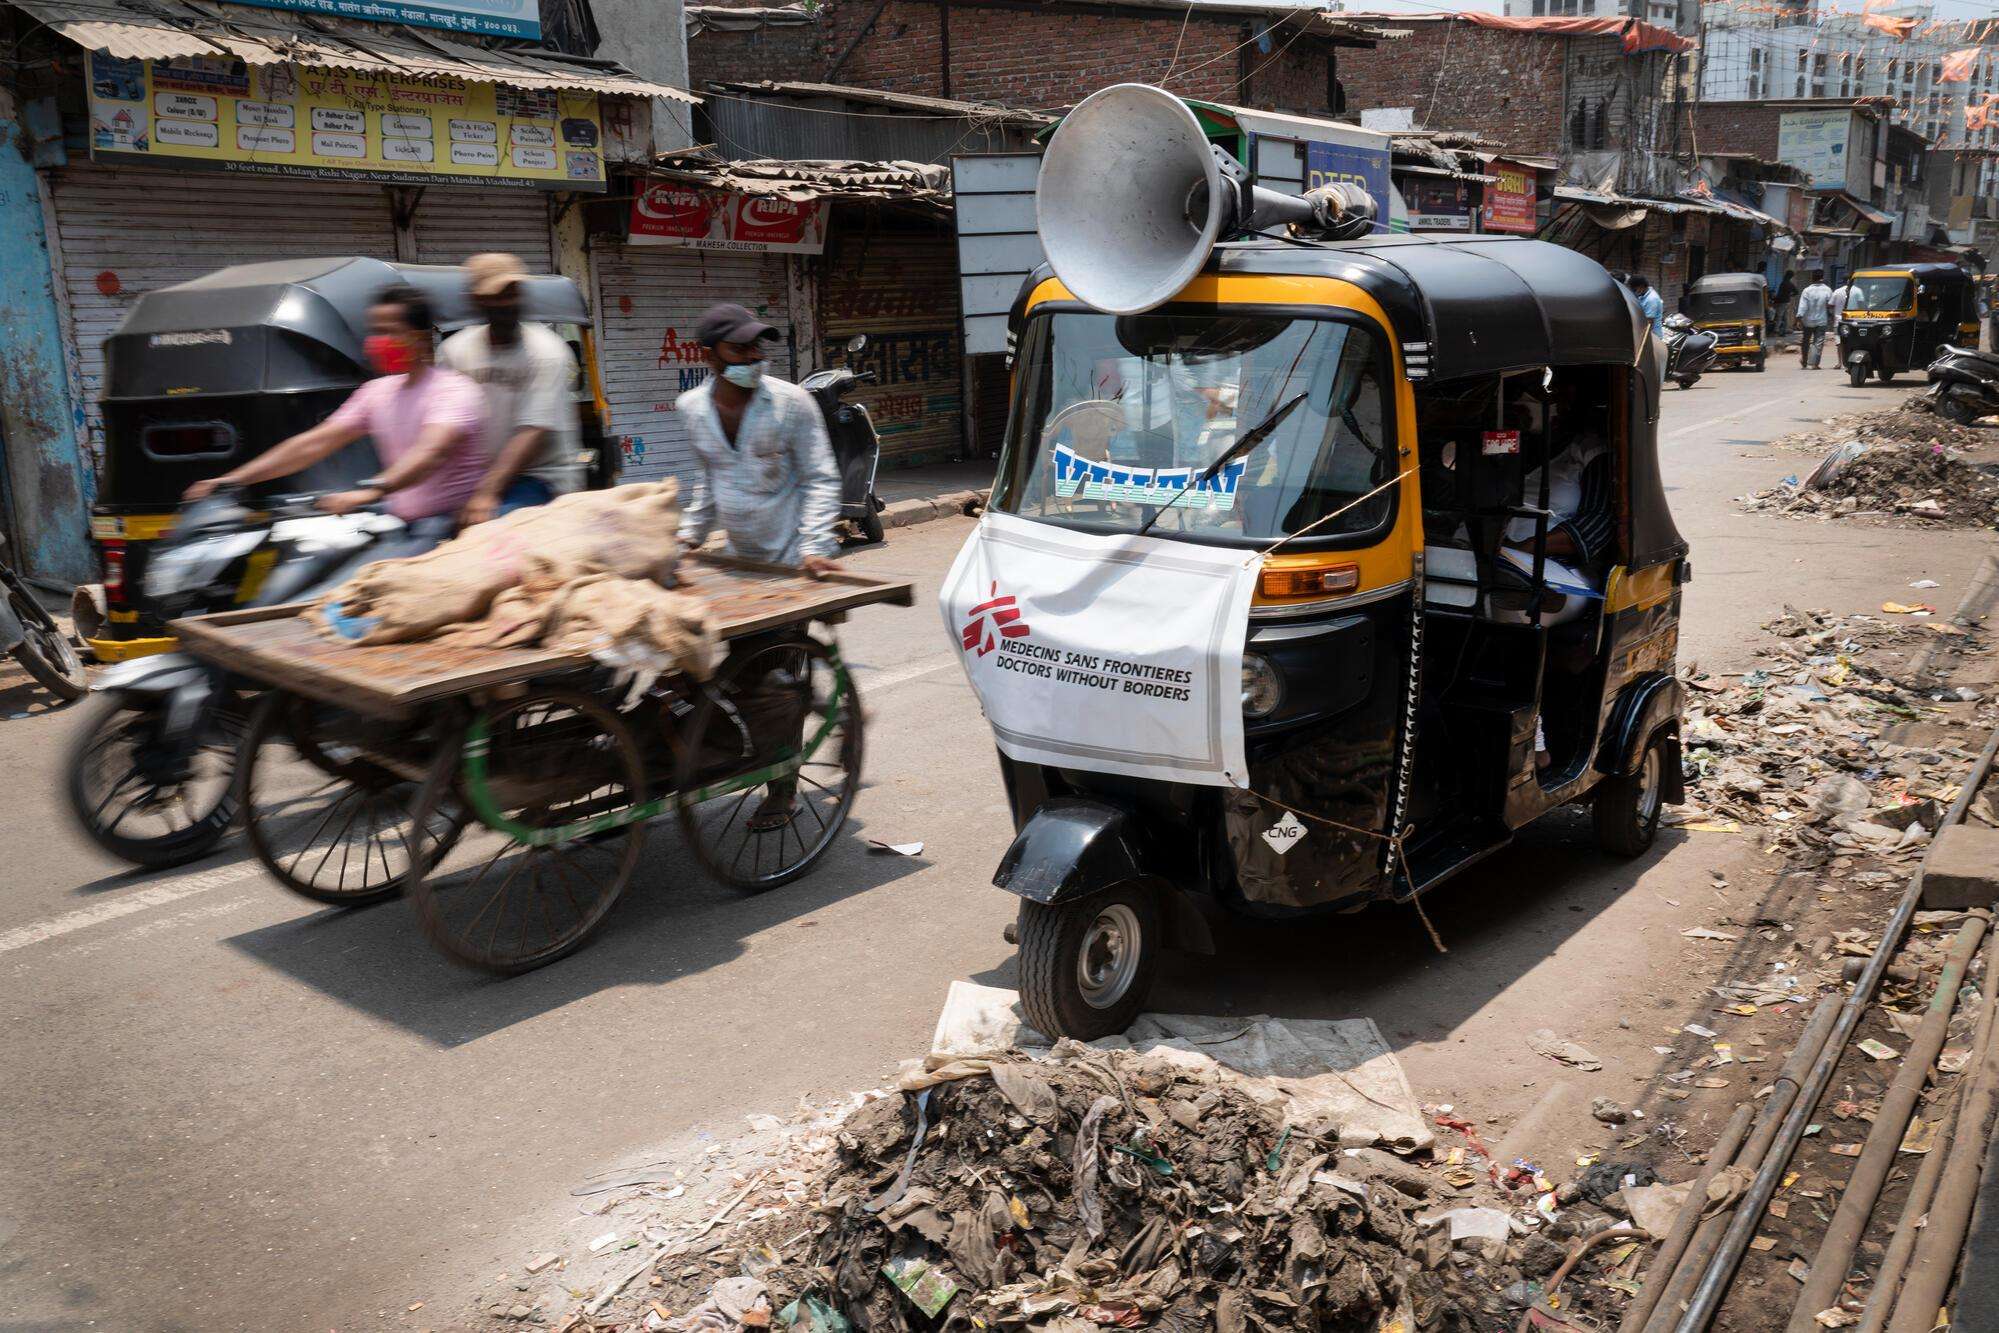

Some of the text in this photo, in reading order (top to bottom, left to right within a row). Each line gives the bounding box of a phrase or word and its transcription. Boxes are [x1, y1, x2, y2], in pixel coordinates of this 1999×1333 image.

[654, 189, 700, 207] RUPA
[756, 198, 799, 216] RUPA
[696, 239, 768, 251] MAHESH COLLECTION
[678, 367, 712, 392] Mil
[1000, 638, 1193, 684] MEDECINS SANS FRONTIERES
[996, 655, 1192, 702] DOCTORS WITHOUT BORDERS
[1268, 826, 1298, 839] CNG
